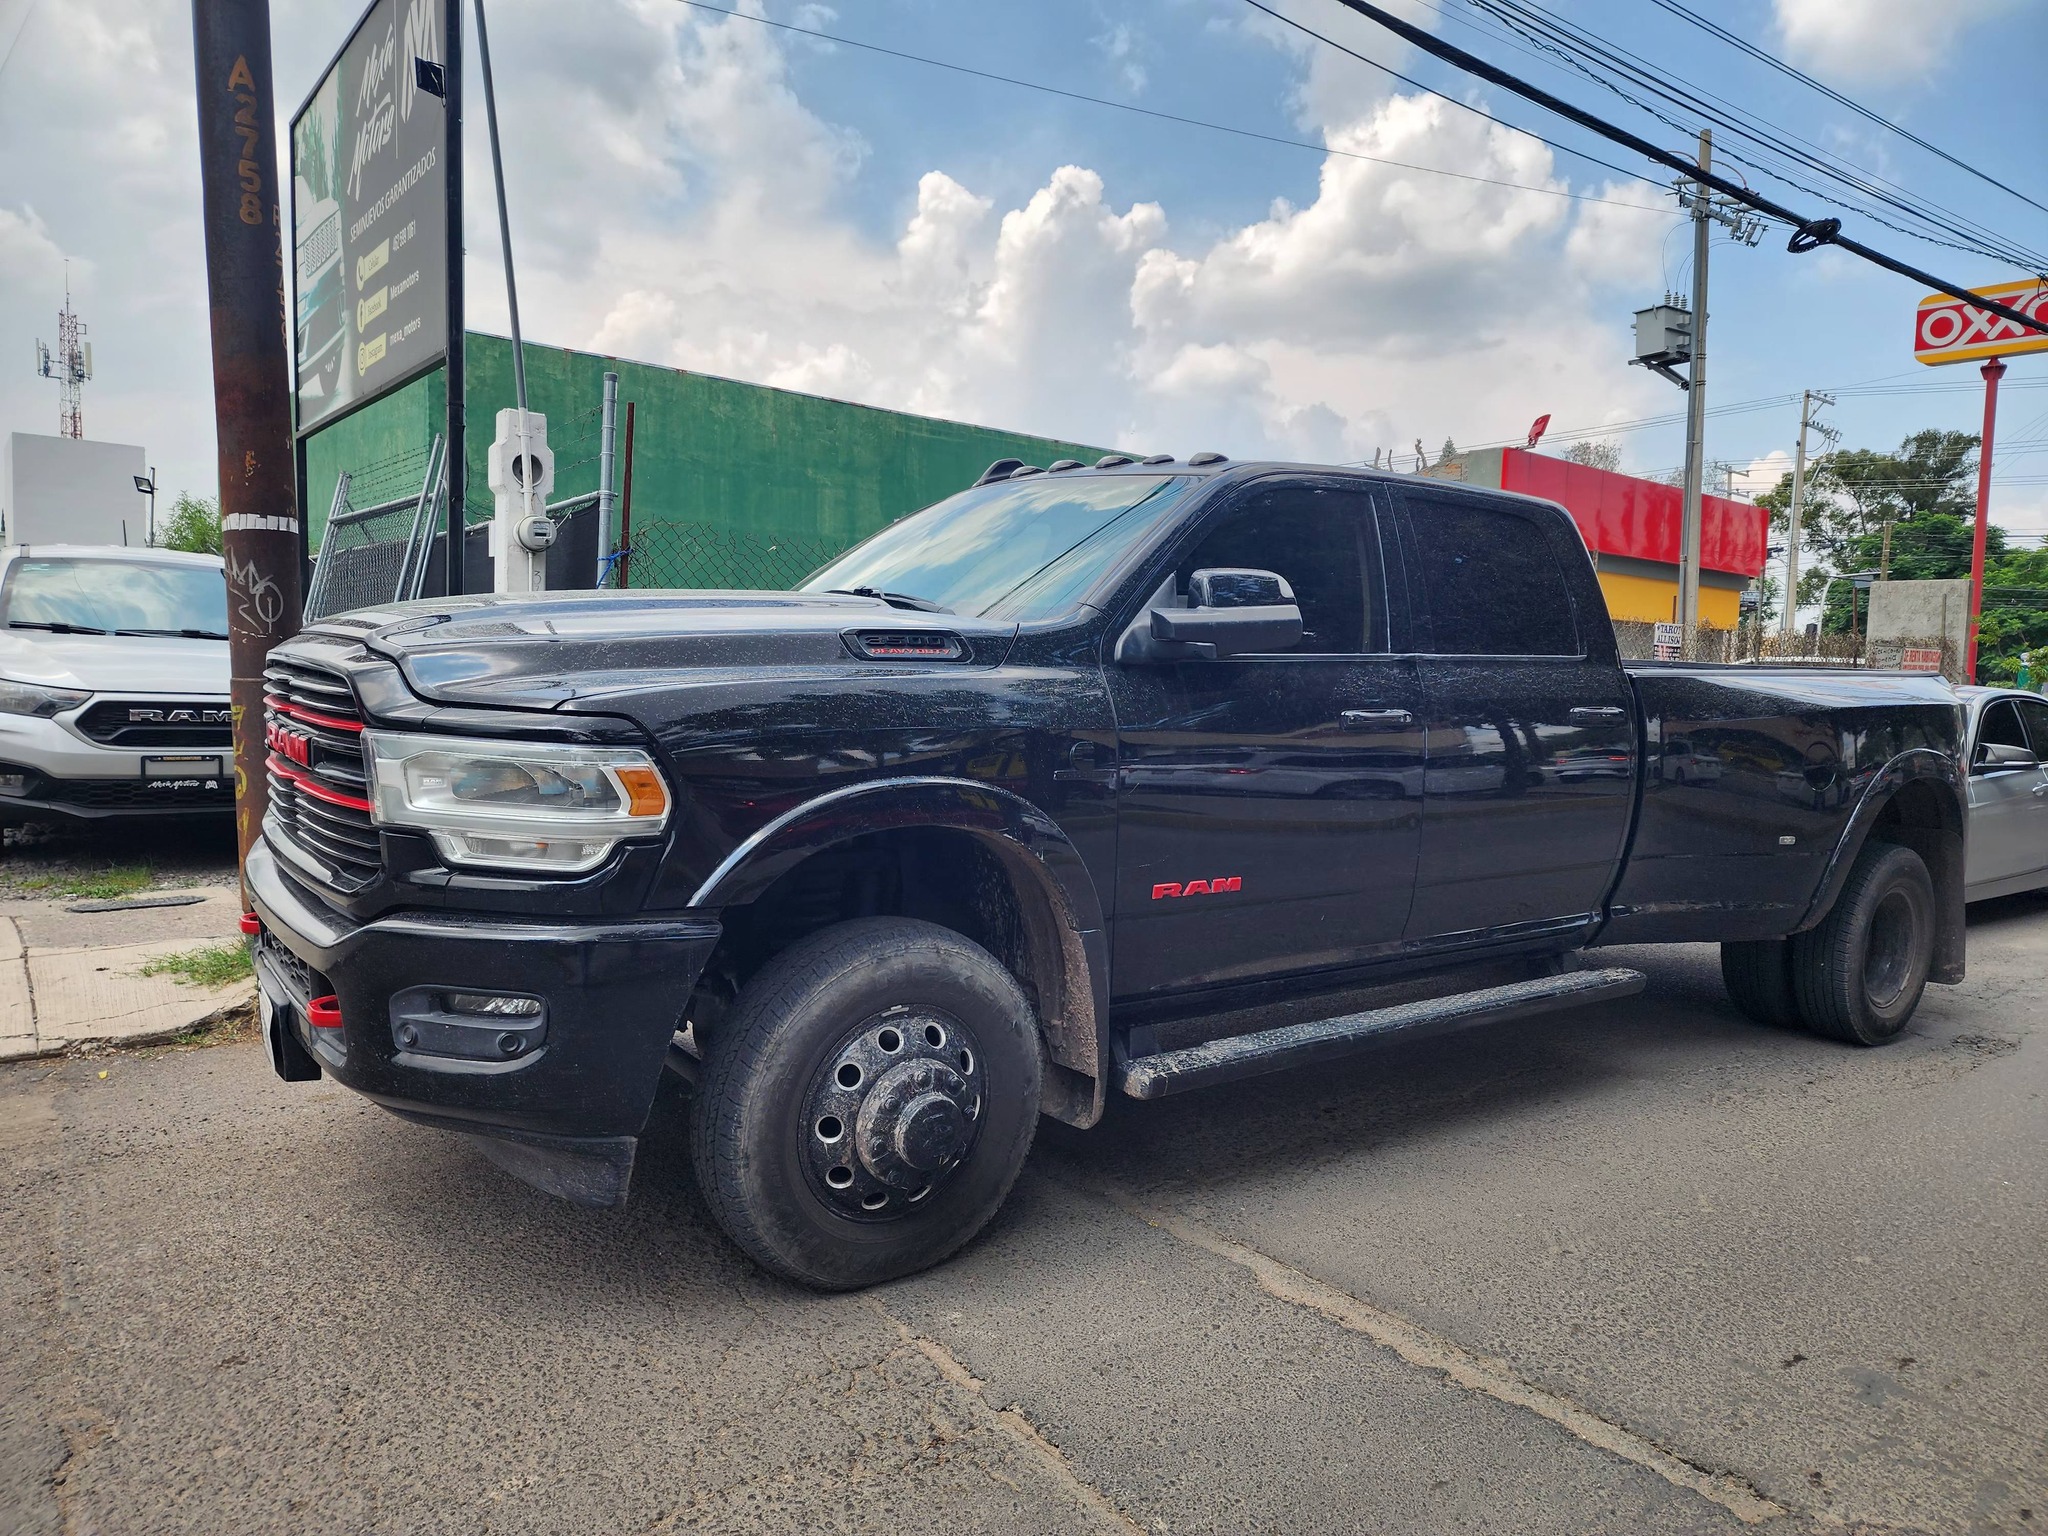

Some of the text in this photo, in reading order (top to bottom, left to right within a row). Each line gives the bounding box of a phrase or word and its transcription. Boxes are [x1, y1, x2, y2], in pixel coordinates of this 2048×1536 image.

[227, 54, 263, 226] A2758
[350, 146, 436, 243] SEMINUEVOS GARANTIZADOS
[390, 317, 421, 346] mexa_motors
[129, 709, 232, 722] RAM
[267, 720, 310, 766] RAM
[1152, 876, 1242, 900] RAM
